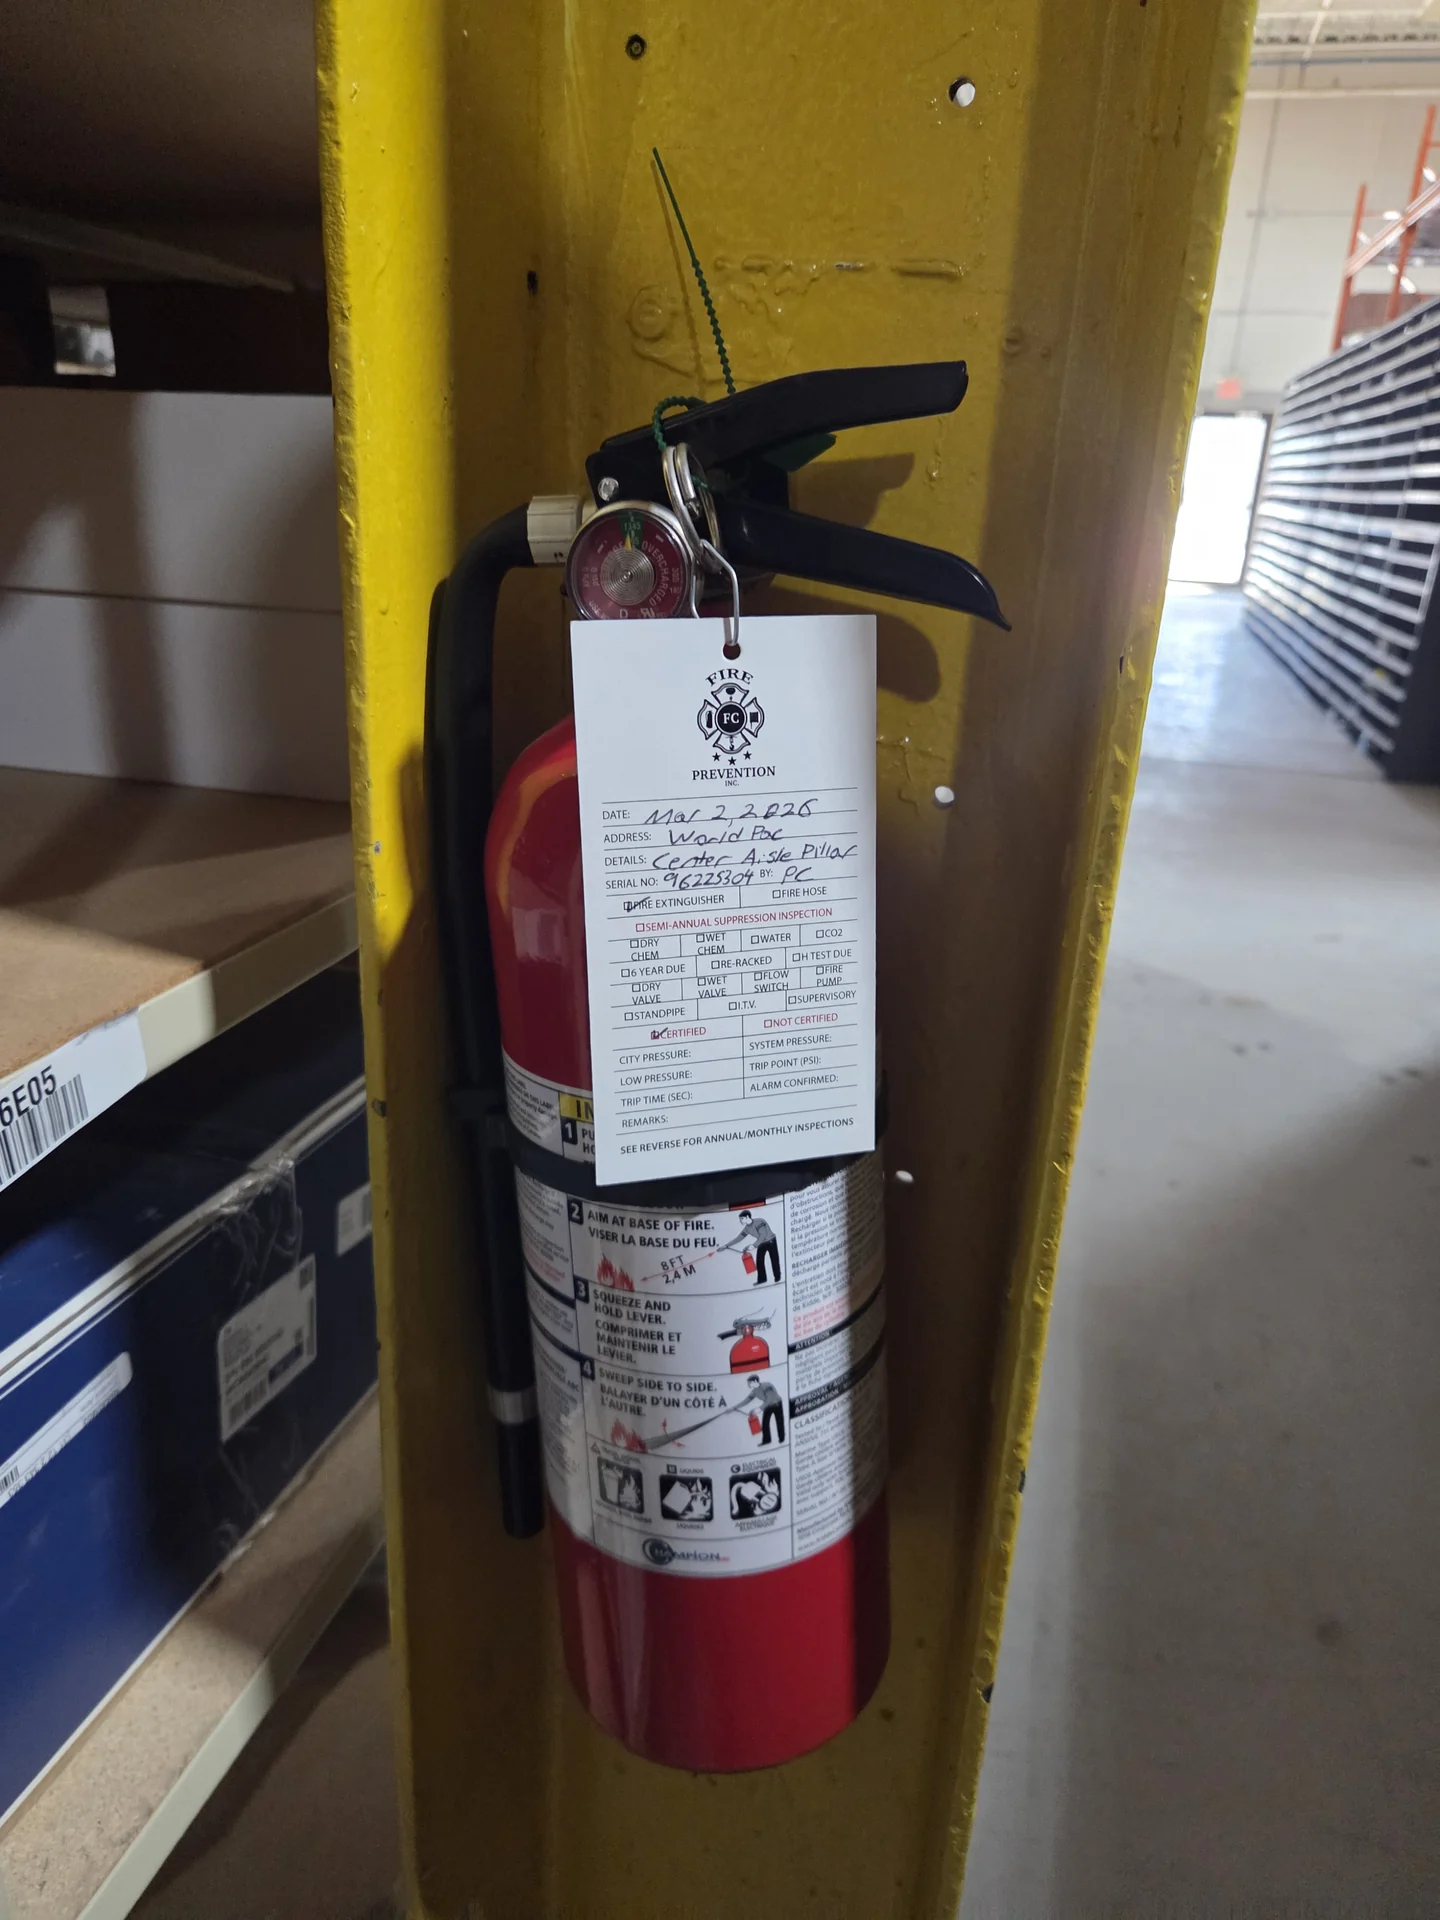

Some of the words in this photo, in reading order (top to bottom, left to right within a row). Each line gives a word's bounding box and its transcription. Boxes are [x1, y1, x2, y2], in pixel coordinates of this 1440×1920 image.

[642, 540, 670, 606] OVERCHARGED
[705, 668, 753, 687] FIRE
[723, 713, 739, 724] FC
[692, 766, 776, 780] PREVENTION
[603, 810, 631, 820] DATE:
[645, 809, 701, 825] Mar
[604, 832, 652, 844] ADDRESS:
[668, 827, 743, 846] World
[604, 855, 647, 866] DETAILS:
[652, 851, 732, 871] Center
[801, 842, 858, 860] Pillar
[760, 869, 774, 878] BY:
[781, 866, 815, 885] PC
[606, 879, 638, 890] SERIAL
[640, 878, 659, 887] NO:
[782, 888, 800, 898] FIRE
[802, 886, 827, 896] HOSE
[634, 899, 653, 910] FIRE
[656, 894, 725, 909] EXTINGUISHER
[646, 918, 712, 932] SEMI-ANNUAL
[714, 912, 777, 926] SUPPRESSION
[779, 908, 833, 920] INSPECTION
[706, 933, 726, 942] WET
[760, 933, 791, 944] WATER
[825, 928, 843, 938] CO2
[640, 938, 660, 948] DRY
[698, 945, 725, 956] CHEM
[631, 951, 660, 961] CHEM
[802, 953, 808, 961] H
[811, 950, 831, 960] TEST
[834, 948, 852, 958] DUE
[721, 956, 772, 969] RE-RACKED
[825, 965, 843, 974] FIRE
[631, 968, 637, 977] 6
[639, 966, 664, 977] YEAR
[666, 964, 686, 974] DUE
[764, 970, 789, 980] FLOW
[642, 982, 661, 992] DRY
[706, 976, 727, 985] WET
[754, 982, 789, 993] SWITCH
[817, 977, 842, 987] PUMP
[632, 994, 661, 1005] VALVE
[698, 988, 727, 998] VALVE
[798, 990, 856, 1004] SUPERVISORY
[634, 1008, 686, 1020] STANDPIPE
[773, 1017, 793, 1028] NOT
[794, 1013, 838, 1025] CERTIFIED
[660, 1027, 707, 1039] CERTIFIED
[750, 1039, 784, 1051] SYSTEM
[786, 1034, 832, 1046] PRESSURE:
[619, 1055, 641, 1065] CITY
[642, 1050, 692, 1063] PRESSURE:
[750, 1062, 769, 1072] TRIP
[771, 1058, 799, 1069] POINT
[800, 1056, 822, 1067] (PSI):
[620, 1076, 642, 1086] LOW
[644, 1070, 693, 1084] PRESSURE:
[750, 1080, 782, 1092] ALARM
[784, 1074, 839, 1088] CONFIRMED:
[621, 1098, 641, 1107] TRIP
[643, 1094, 666, 1105] TIME
[668, 1092, 693, 1103] (SEC):
[622, 1115, 669, 1128] REMARKS:
[565, 1122, 572, 1139] 1
[620, 1145, 637, 1155] SEE
[640, 1139, 681, 1152] REVERSE
[684, 1137, 703, 1147] FOR
[704, 1125, 793, 1144] ANNUAL/MONTHLY
[794, 1118, 854, 1132] INSPECTIONS
[572, 1202, 580, 1219] 2
[588, 1210, 609, 1224] AIM
[612, 1215, 626, 1227] AT
[630, 1218, 660, 1230] BASE
[664, 1220, 680, 1231] OF
[684, 1220, 715, 1231] FIRE.
[588, 1226, 618, 1243] VISER
[622, 1234, 636, 1246] LA
[640, 1236, 670, 1248] BASE
[672, 1238, 690, 1248] DU
[694, 1237, 720, 1248] FEU.
[578, 1280, 586, 1297] 3
[593, 1289, 641, 1309] SQUEEZE
[644, 1300, 671, 1312] AND
[594, 1302, 623, 1318] HOLD
[626, 1310, 666, 1325] LEVER.
[595, 1319, 664, 1342] COMPRIMER
[668, 1332, 682, 1342] ET
[596, 1332, 659, 1354] MAINTENIR
[662, 1344, 676, 1355] LE
[597, 1344, 637, 1364] LEVIER.
[583, 1361, 592, 1376] 4
[598, 1367, 634, 1385] SWEEP
[637, 1378, 664, 1391] SIDE
[666, 1382, 682, 1392] TO
[686, 1382, 718, 1392] SIDE.
[600, 1383, 648, 1404] BALAYER
[650, 1396, 680, 1408] D'UN
[684, 1396, 715, 1409] CÔTÉ
[718, 1395, 728, 1407] À
[601, 1396, 646, 1417] L'AUTRE.
